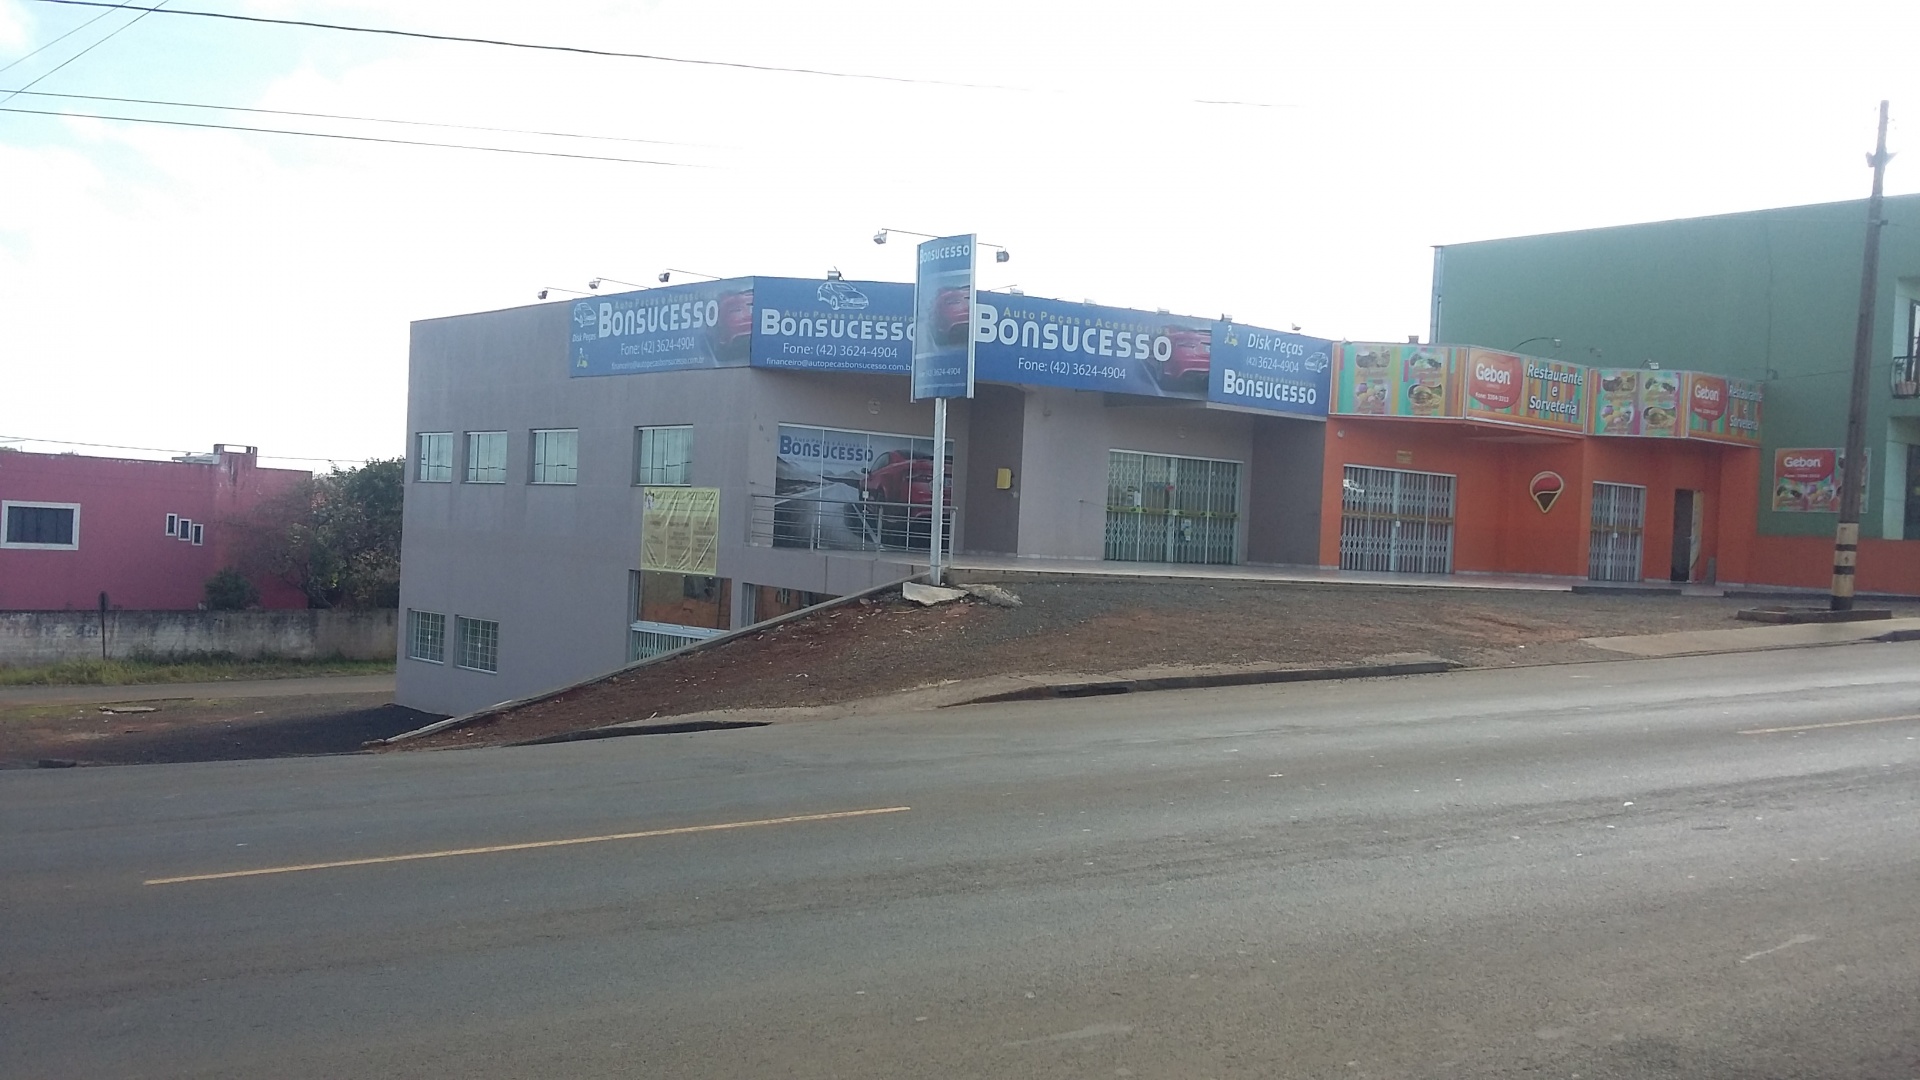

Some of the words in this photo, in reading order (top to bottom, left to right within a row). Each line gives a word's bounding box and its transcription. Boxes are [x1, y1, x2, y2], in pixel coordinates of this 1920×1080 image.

[599, 300, 718, 338] BONSUCESSO
[784, 310, 809, 318] Auto
[813, 311, 845, 320] Peças
[858, 313, 914, 322] Acessório
[1003, 307, 1035, 320] Auto
[1041, 311, 1080, 326] Peças
[1096, 318, 1170, 334] Acessórios
[975, 303, 1171, 361] BONSUCESSO
[621, 343, 639, 355] Fone:
[641, 341, 655, 355] (42)
[656, 337, 695, 353] 3624-4904
[783, 342, 813, 355] Fone:
[816, 344, 837, 357] (42)
[840, 346, 898, 358] 3624-4904
[1248, 333, 1271, 351] Disk
[1273, 338, 1303, 358] Peças
[1018, 357, 1047, 372] Fone:
[1050, 360, 1070, 376] (42)
[1073, 363, 1126, 379] 3624-4904
[1258, 356, 1299, 373] 3624-4904
[1475, 363, 1511, 385] Gebon
[1526, 364, 1583, 386] Restaurante
[1223, 369, 1316, 405] BONSUCESSO
[1551, 386, 1558, 397] e
[1695, 384, 1719, 401] Gebon
[1529, 396, 1577, 415] Sorveteria
[780, 435, 874, 462] BONSUCESSO
[1784, 457, 1821, 468] Gebon
